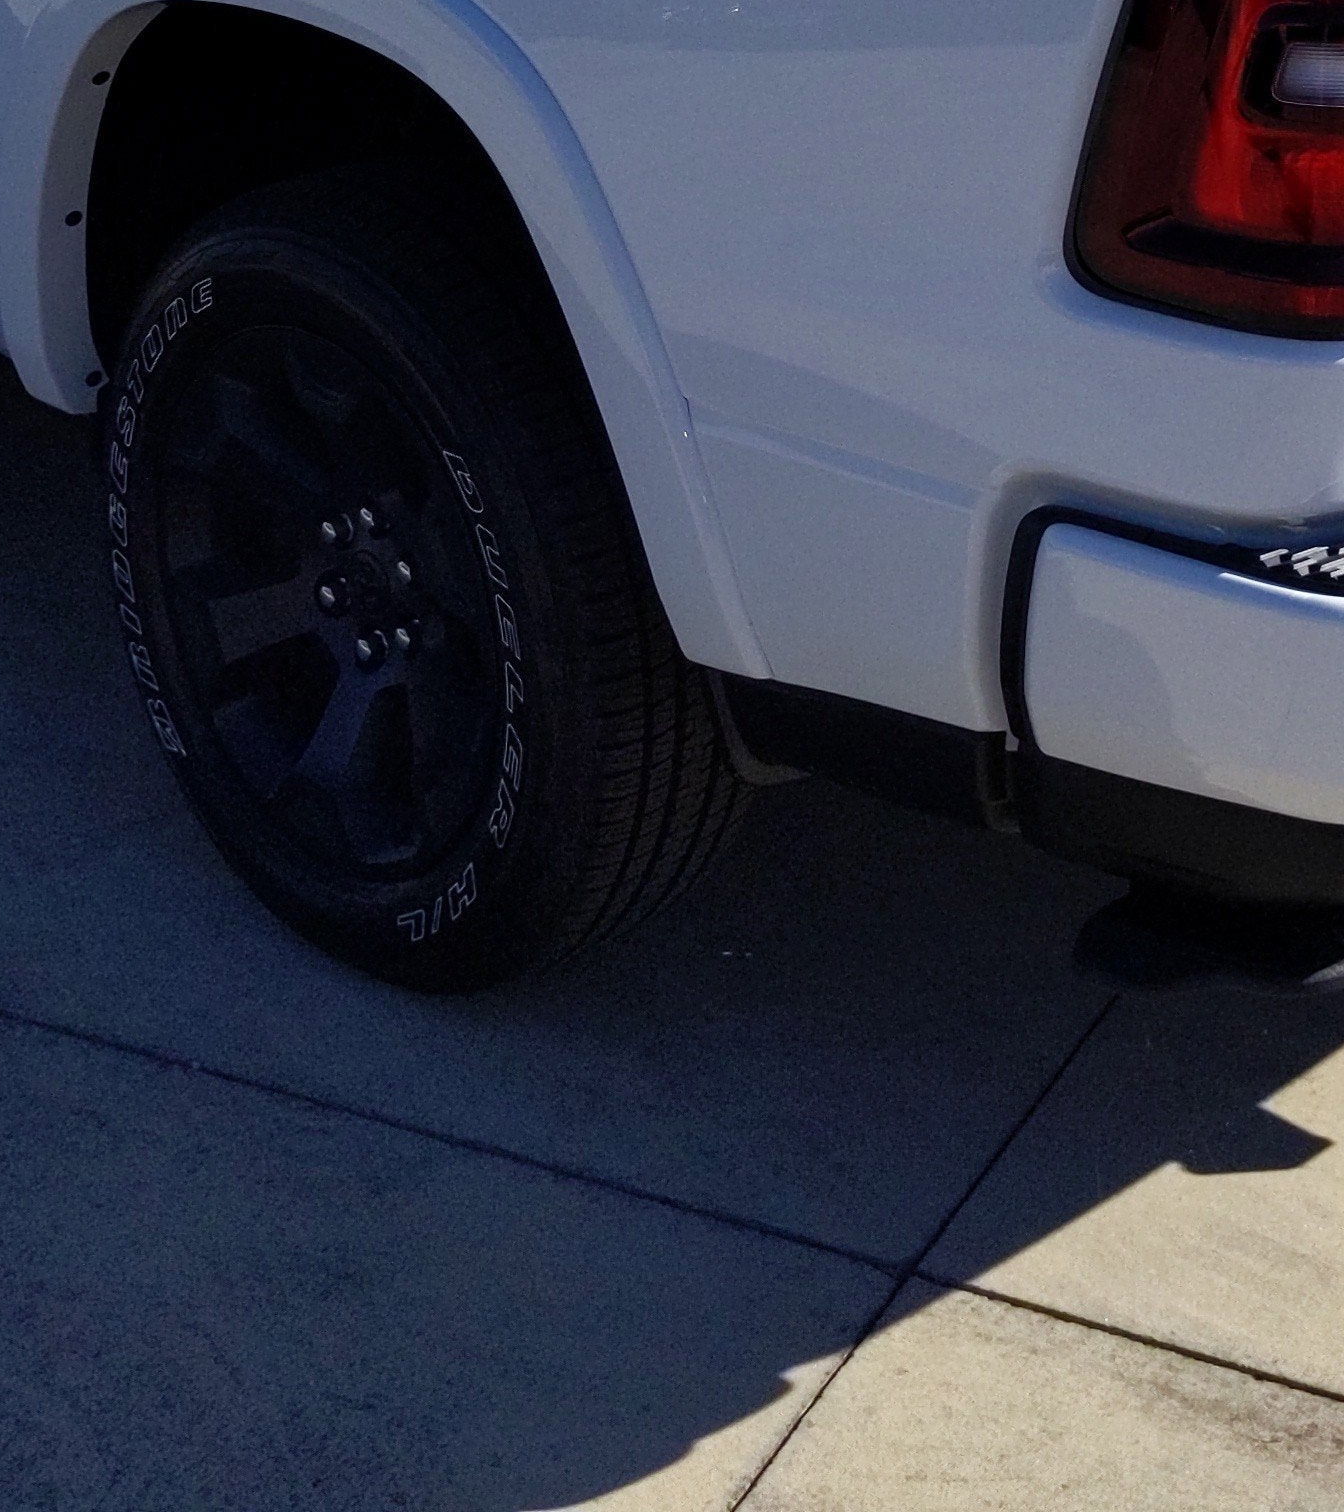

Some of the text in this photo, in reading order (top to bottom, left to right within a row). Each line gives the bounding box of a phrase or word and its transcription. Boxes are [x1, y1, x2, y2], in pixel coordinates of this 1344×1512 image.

[108, 277, 213, 757] BRIDGESTONE
[397, 450, 524, 942] DUELER H/L
